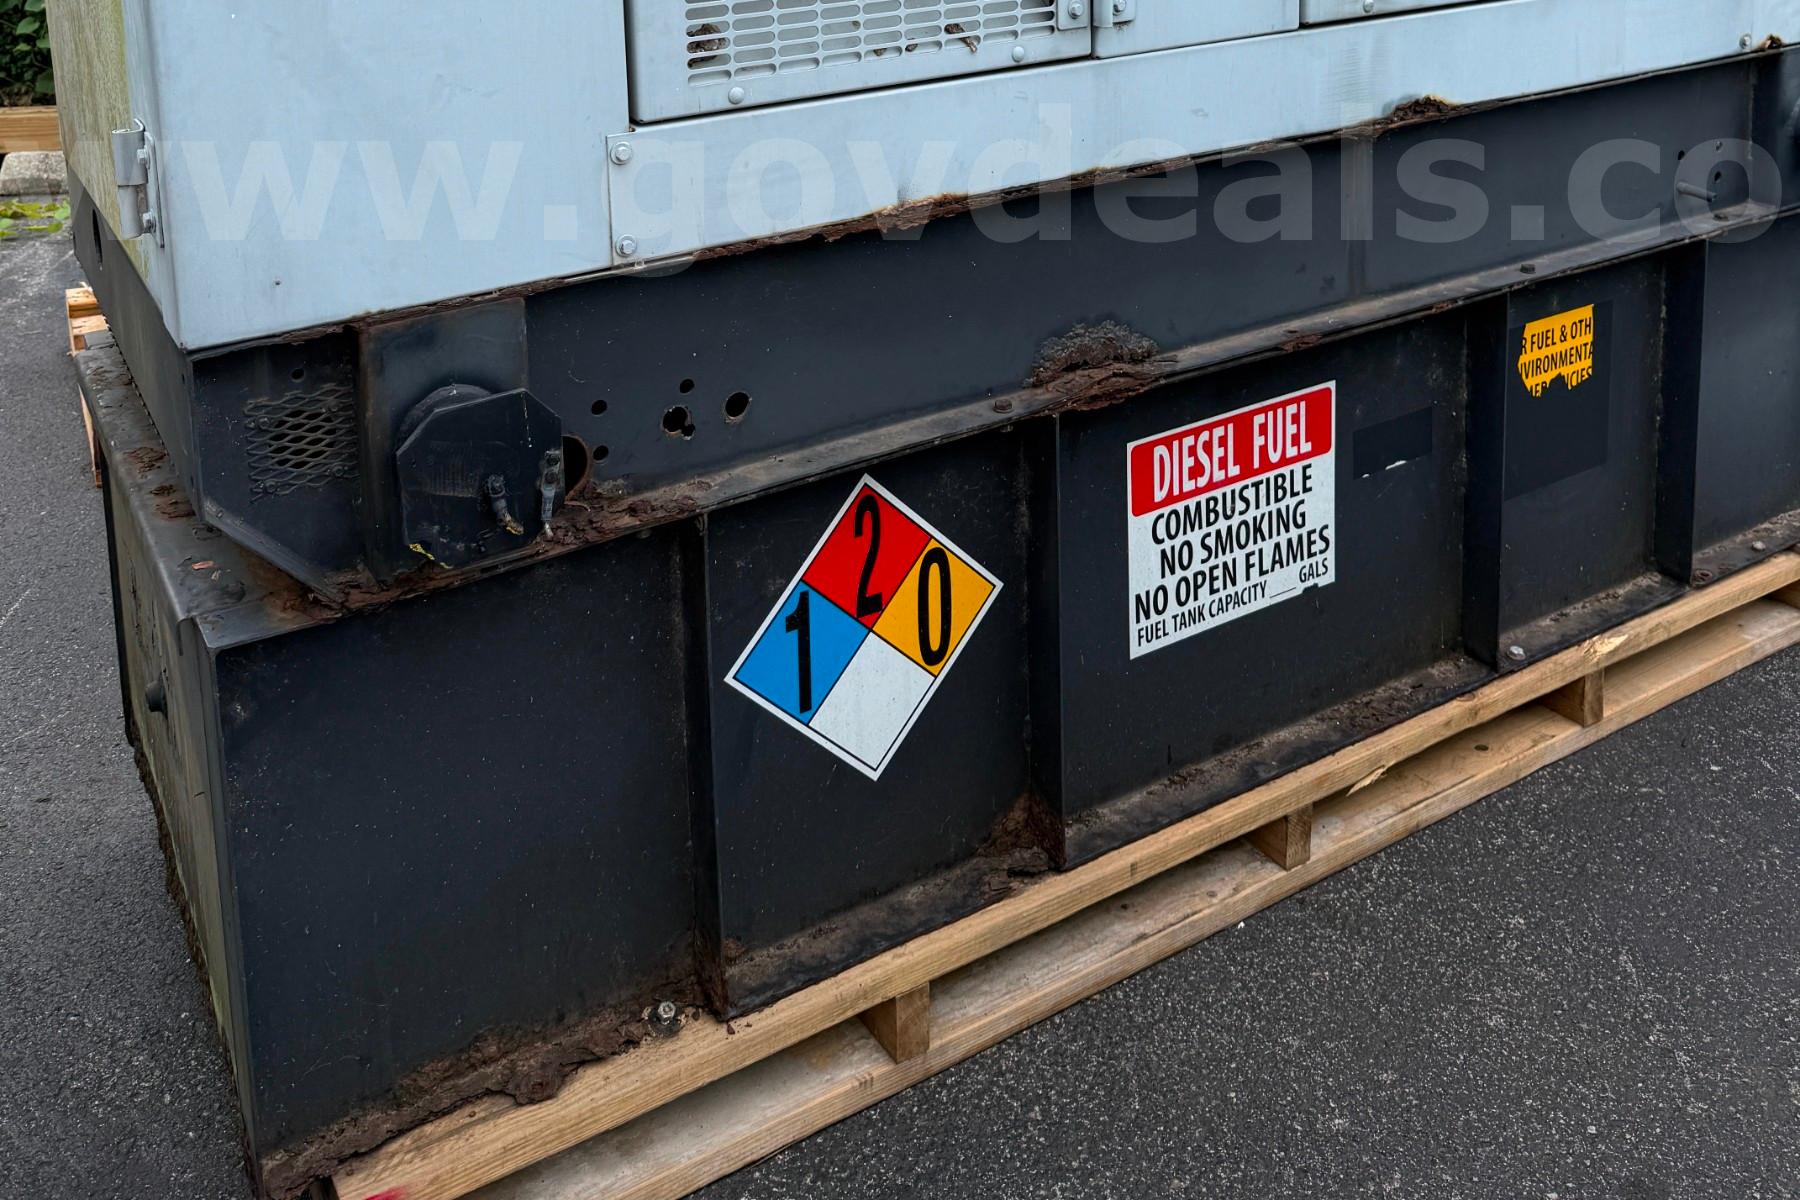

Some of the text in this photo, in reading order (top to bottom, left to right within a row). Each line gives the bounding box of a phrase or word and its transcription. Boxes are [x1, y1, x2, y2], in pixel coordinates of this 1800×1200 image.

[1530, 328, 1557, 353] FUEL
[1559, 324, 1568, 343] &
[1570, 316, 1592, 339] OTH
[1153, 400, 1312, 503] DIESEL FUEL
[1151, 463, 1313, 545] COMBUSTIBLE
[1160, 499, 1307, 579] NO SMOKING
[854, 493, 883, 619] 2
[917, 546, 951, 667] 0
[1134, 523, 1330, 624] NO OPEN FLAMES
[1137, 557, 1329, 647] FUEL TANK CAPACITY GALS
[785, 590, 812, 714] 1
